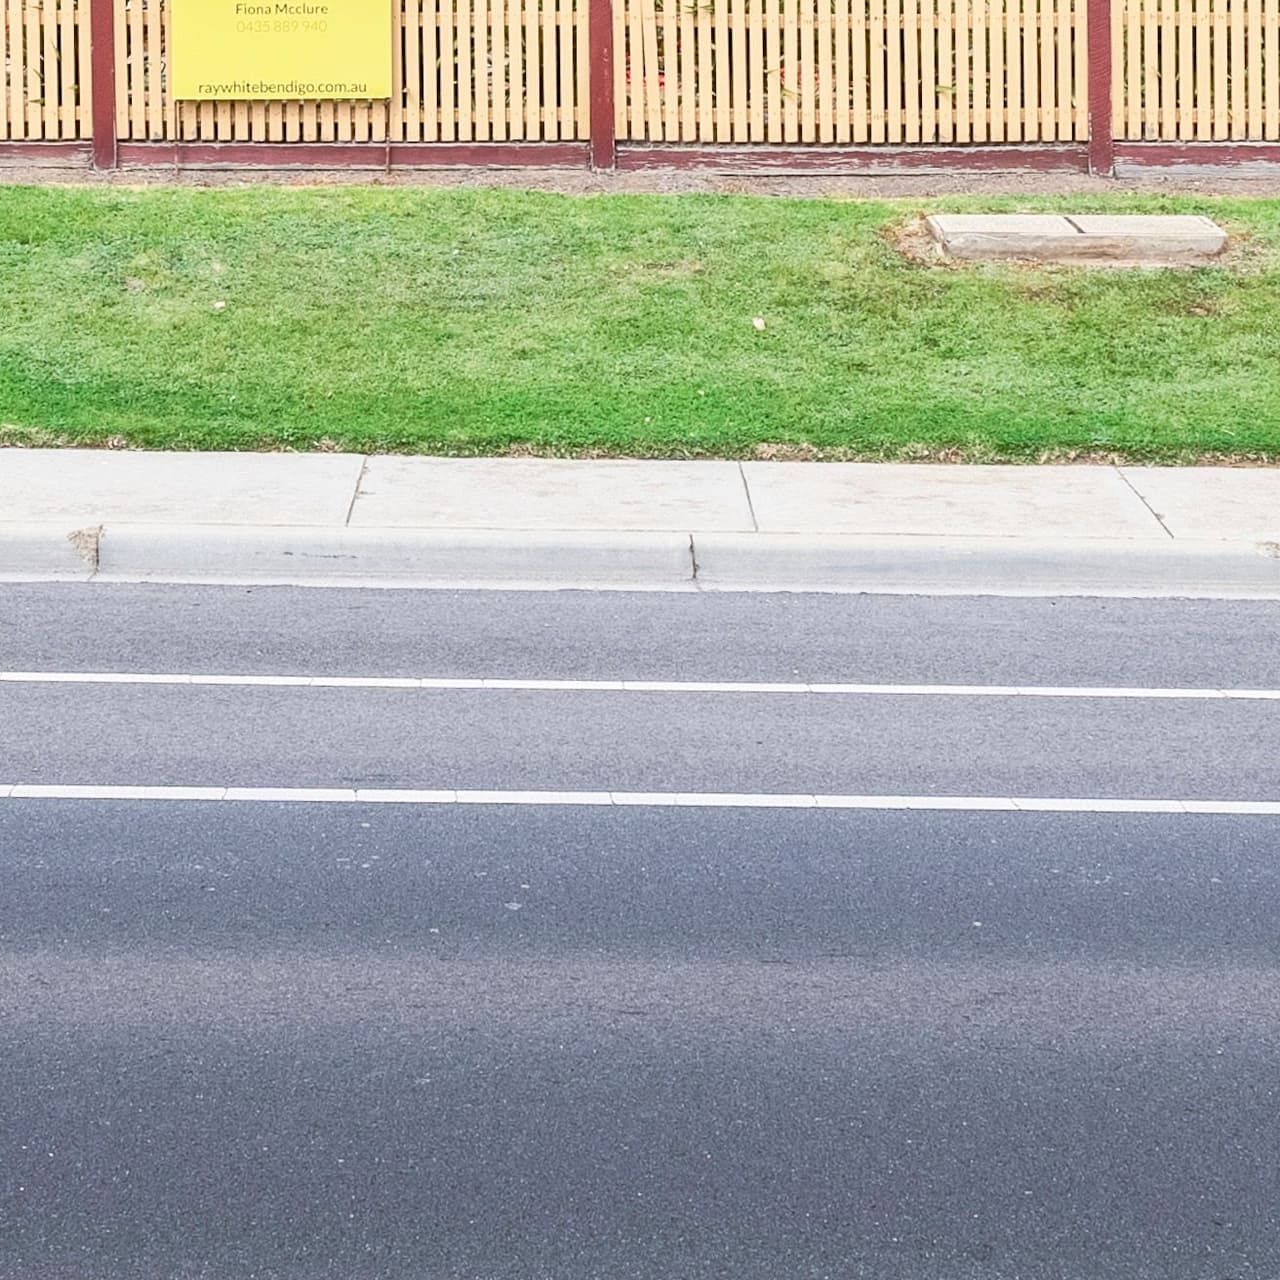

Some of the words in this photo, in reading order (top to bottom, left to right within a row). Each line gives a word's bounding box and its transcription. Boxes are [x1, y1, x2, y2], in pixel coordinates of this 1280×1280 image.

[235, 3, 272, 15] Fiona
[275, 3, 329, 15] Mcclure
[236, 20, 270, 33] 0435
[198, 80, 367, 96] raywhitebendigo.com.au
